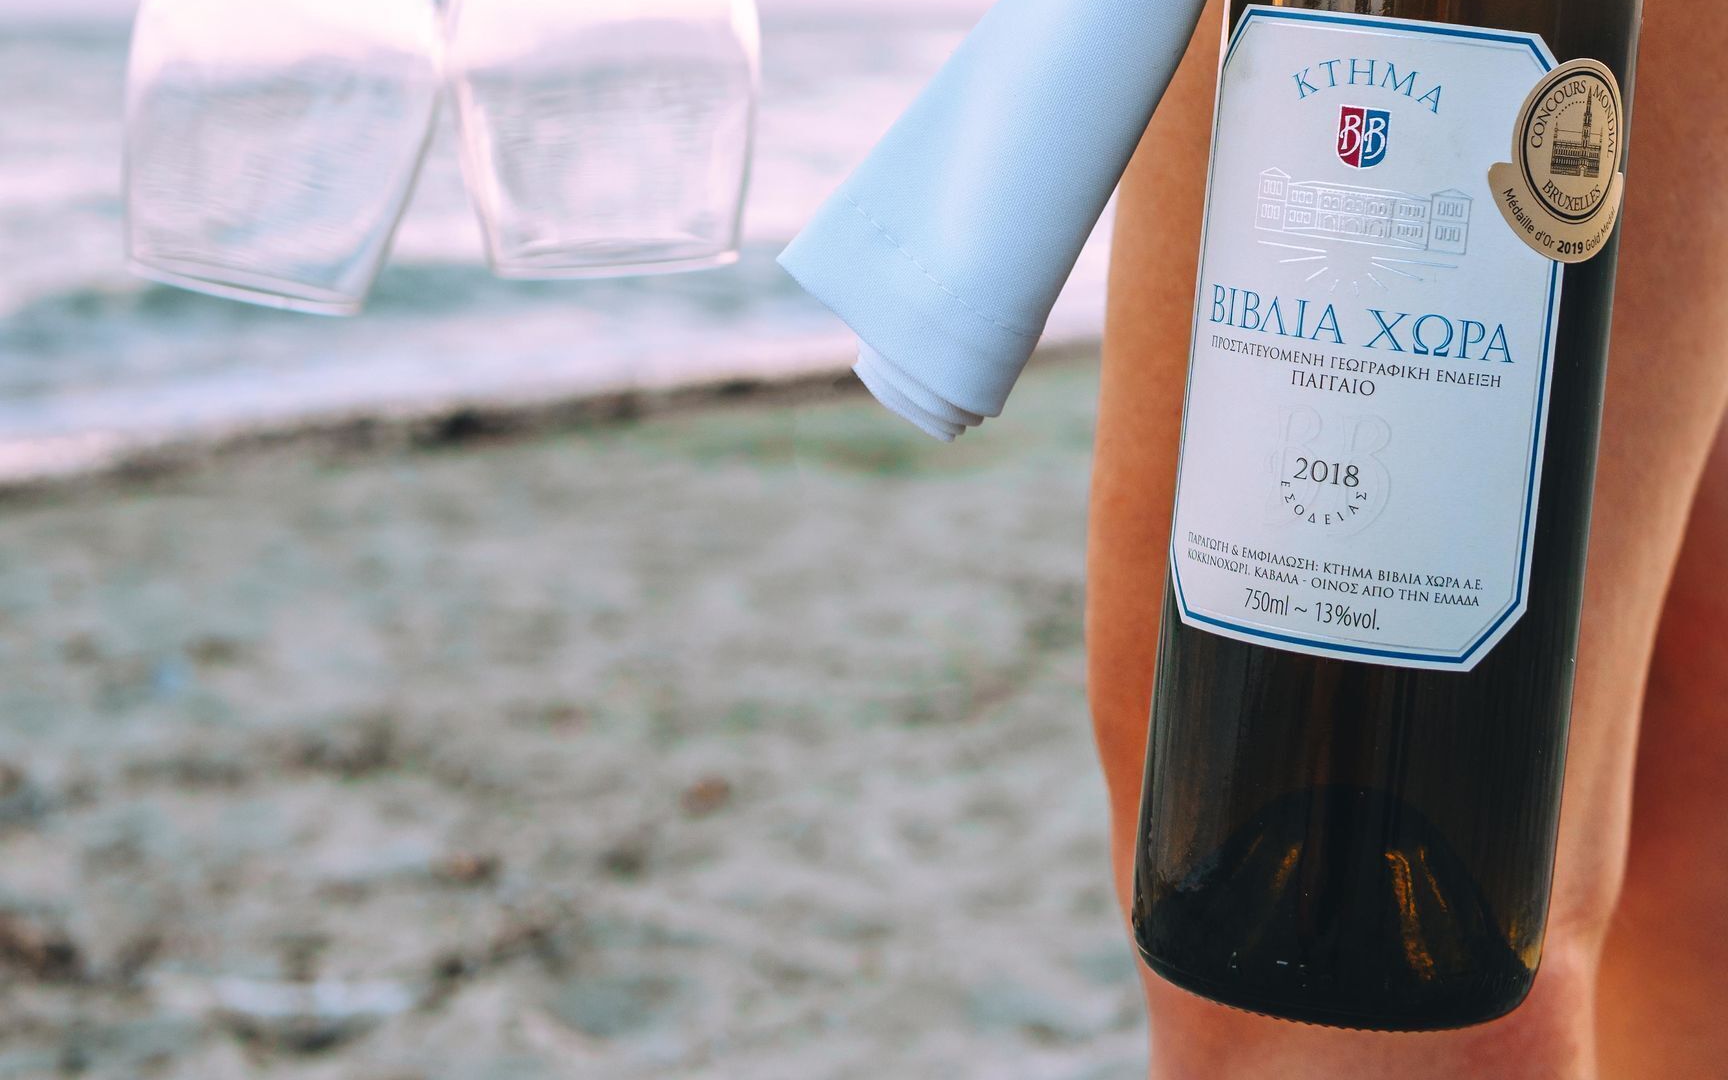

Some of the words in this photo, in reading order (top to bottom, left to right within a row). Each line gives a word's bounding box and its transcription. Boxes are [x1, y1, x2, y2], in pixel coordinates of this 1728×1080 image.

[1292, 58, 1441, 114] ΚΤΗΜΑ
[1531, 80, 1587, 148] CONCOURS
[1593, 84, 1616, 158] MONDIAL
[1542, 179, 1601, 212] BRUXELLES
[1503, 188, 1535, 233] Médaille
[1535, 230, 1555, 249] d'Or
[1557, 240, 1584, 255] 2019
[1586, 232, 1600, 251] Gold
[1209, 284, 1346, 344] ΒΙΒΛΙΑ
[1361, 308, 1515, 364] ΧΩΡΑ
[1211, 335, 1325, 368] ΠΡΟΣΤΑΤΕΥΟΜΕΝΗ
[1330, 356, 1430, 381] ΓΕΩΓΡΑΦΙΚΗ
[1436, 369, 1502, 388] ΕΝΔΕΙΞΗ
[1291, 370, 1376, 396] ΠΑΓΓΑΙΟ
[1293, 457, 1360, 488] 2018
[1280, 480, 1367, 525] ΕΣΟΔΕΙΑΣ
[1187, 531, 1229, 554] ΠΑΡΑΓΩΓΗ
[1231, 544, 1239, 556] &
[1242, 547, 1319, 572] ΕΜΦΙΑΛΩΣΗ:
[1323, 562, 1373, 580] ΚΤΗΜΑ
[1378, 569, 1422, 586] ΒΙΒΛΙΑ
[1425, 575, 1461, 589] ΧΩΡΑ
[1244, 587, 1289, 616] 750ml
[1315, 601, 1380, 631] 13%vol.
[1254, 566, 1299, 585] ΚΑΒΑΛΑ
[1311, 577, 1359, 595] ΟΙΝΟΣ
[1361, 585, 1395, 599] ΑΠΟ
[1399, 589, 1430, 602] ΤΗΝ
[1434, 592, 1480, 607] ΕΛΛΑΔΑ
